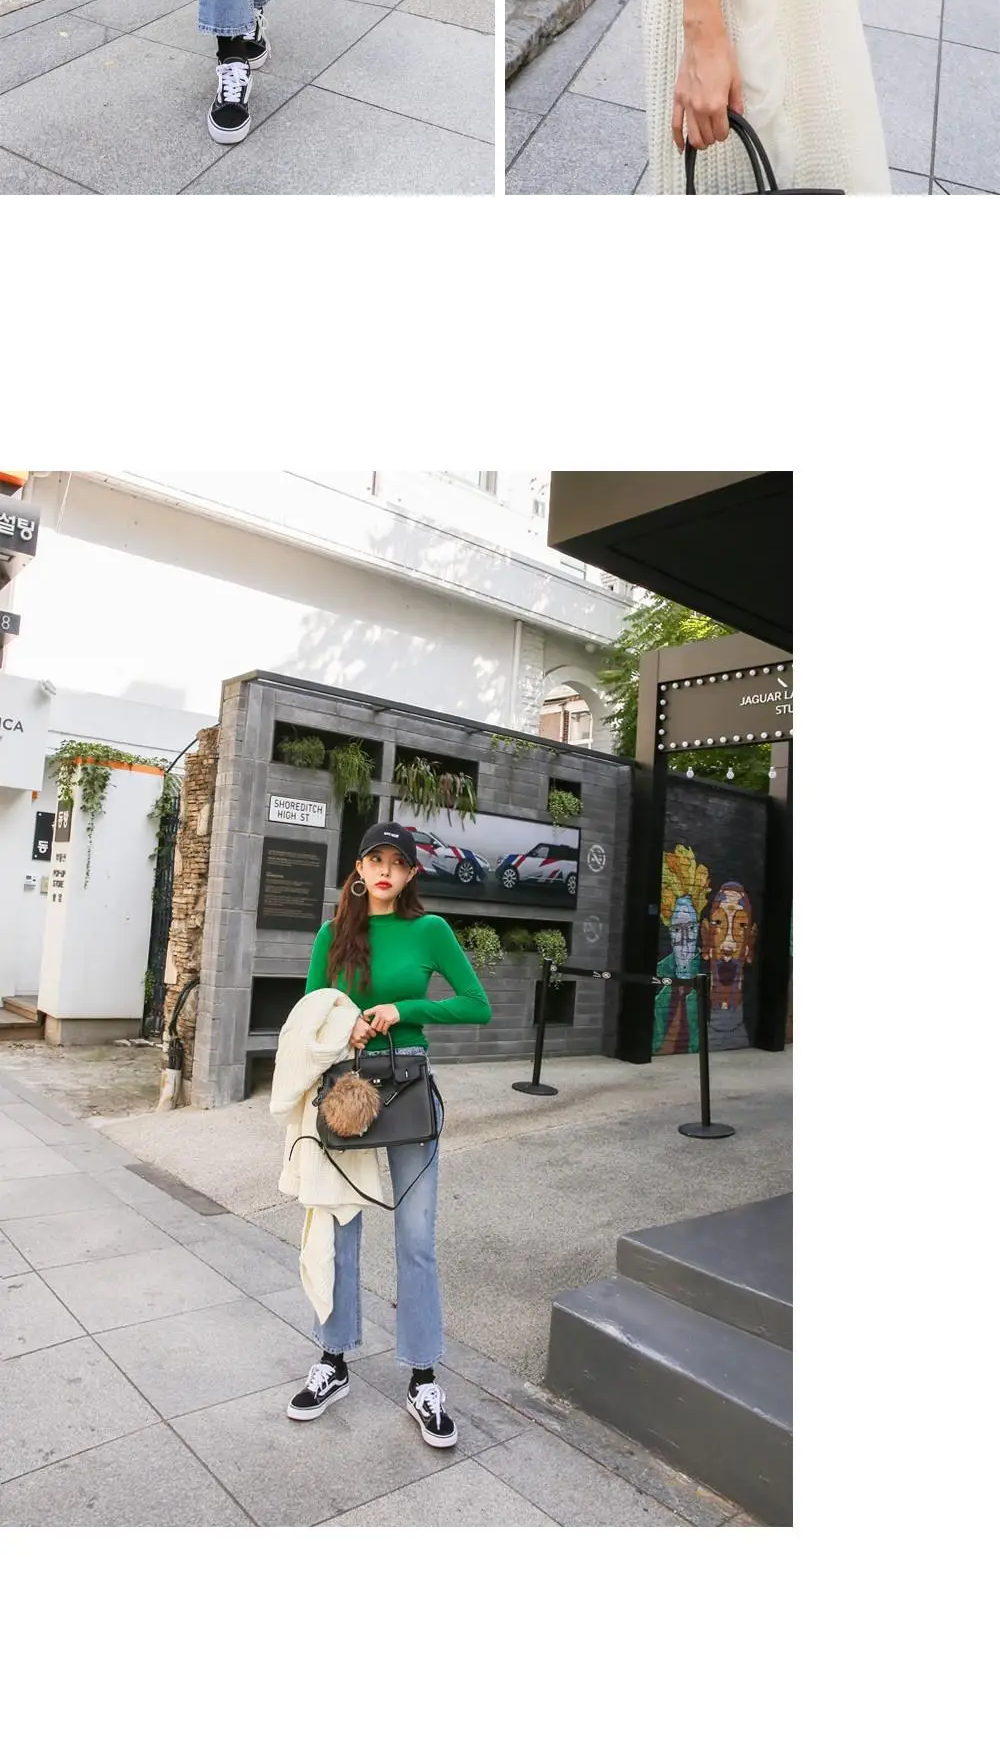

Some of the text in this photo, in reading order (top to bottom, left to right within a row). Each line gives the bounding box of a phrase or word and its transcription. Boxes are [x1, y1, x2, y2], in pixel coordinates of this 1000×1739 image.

[740, 691, 782, 706] JAGUAR
[274, 799, 323, 815] SHOREDITCH
[277, 811, 297, 820] HIGH
